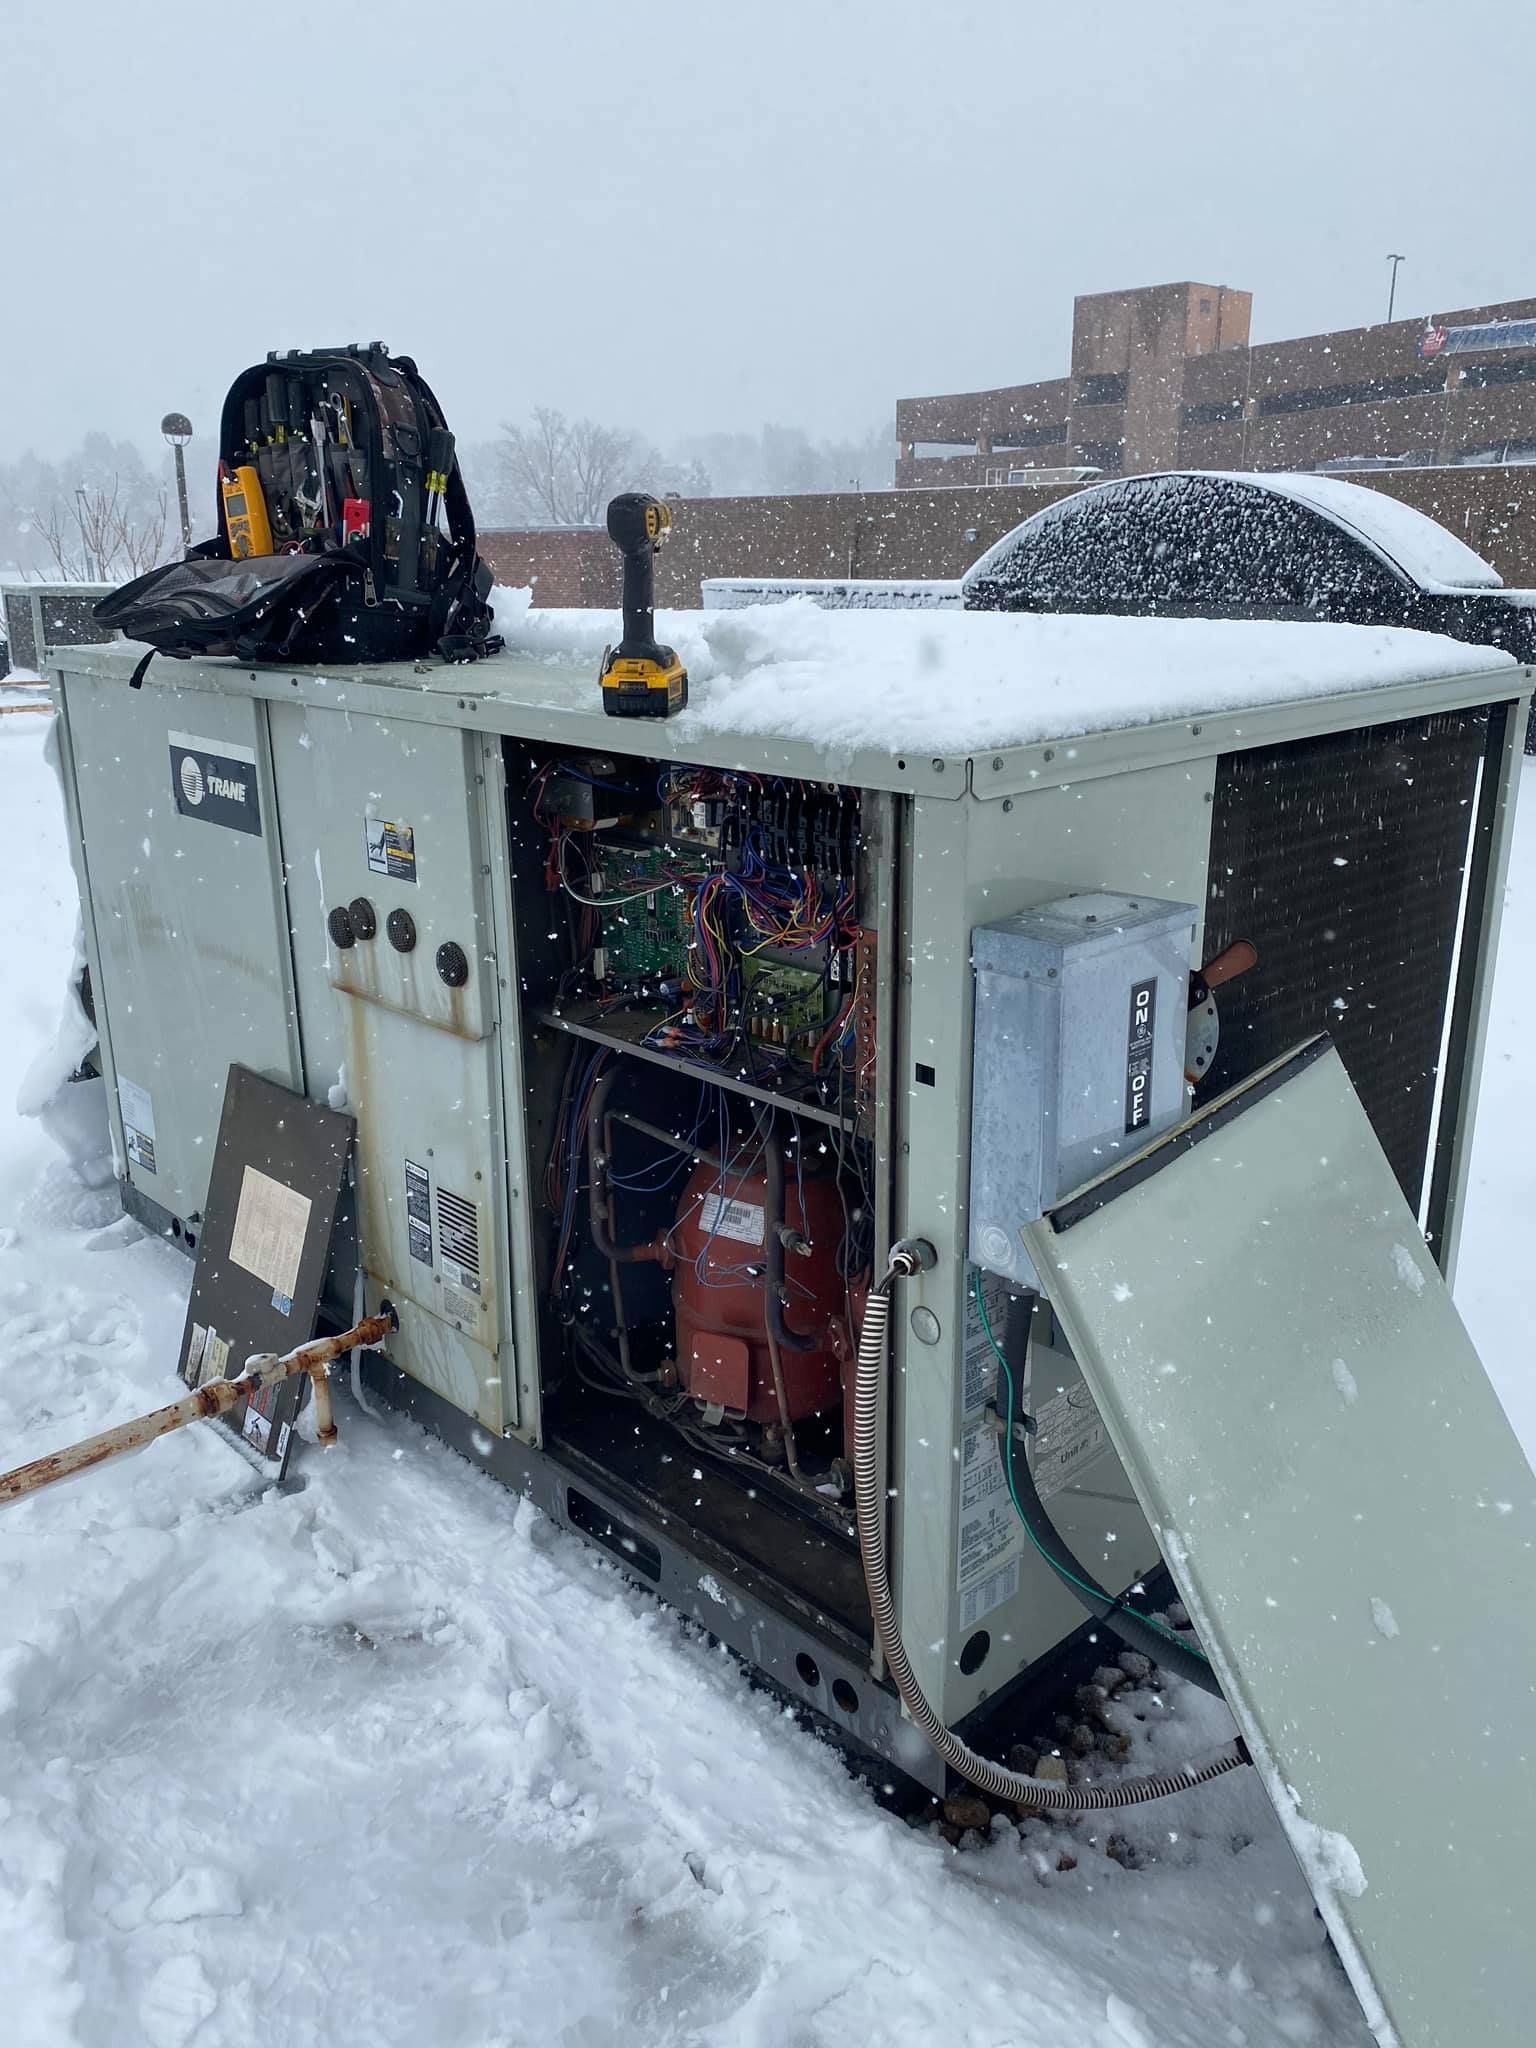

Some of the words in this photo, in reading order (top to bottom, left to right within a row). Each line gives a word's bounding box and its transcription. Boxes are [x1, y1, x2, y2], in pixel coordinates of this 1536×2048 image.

[1426, 331, 1445, 344] 24
[207, 775, 246, 802] TRANE
[1135, 990, 1150, 1026] ON
[1132, 1075, 1145, 1126] OFF
[1061, 1444, 1079, 1463] Unit
